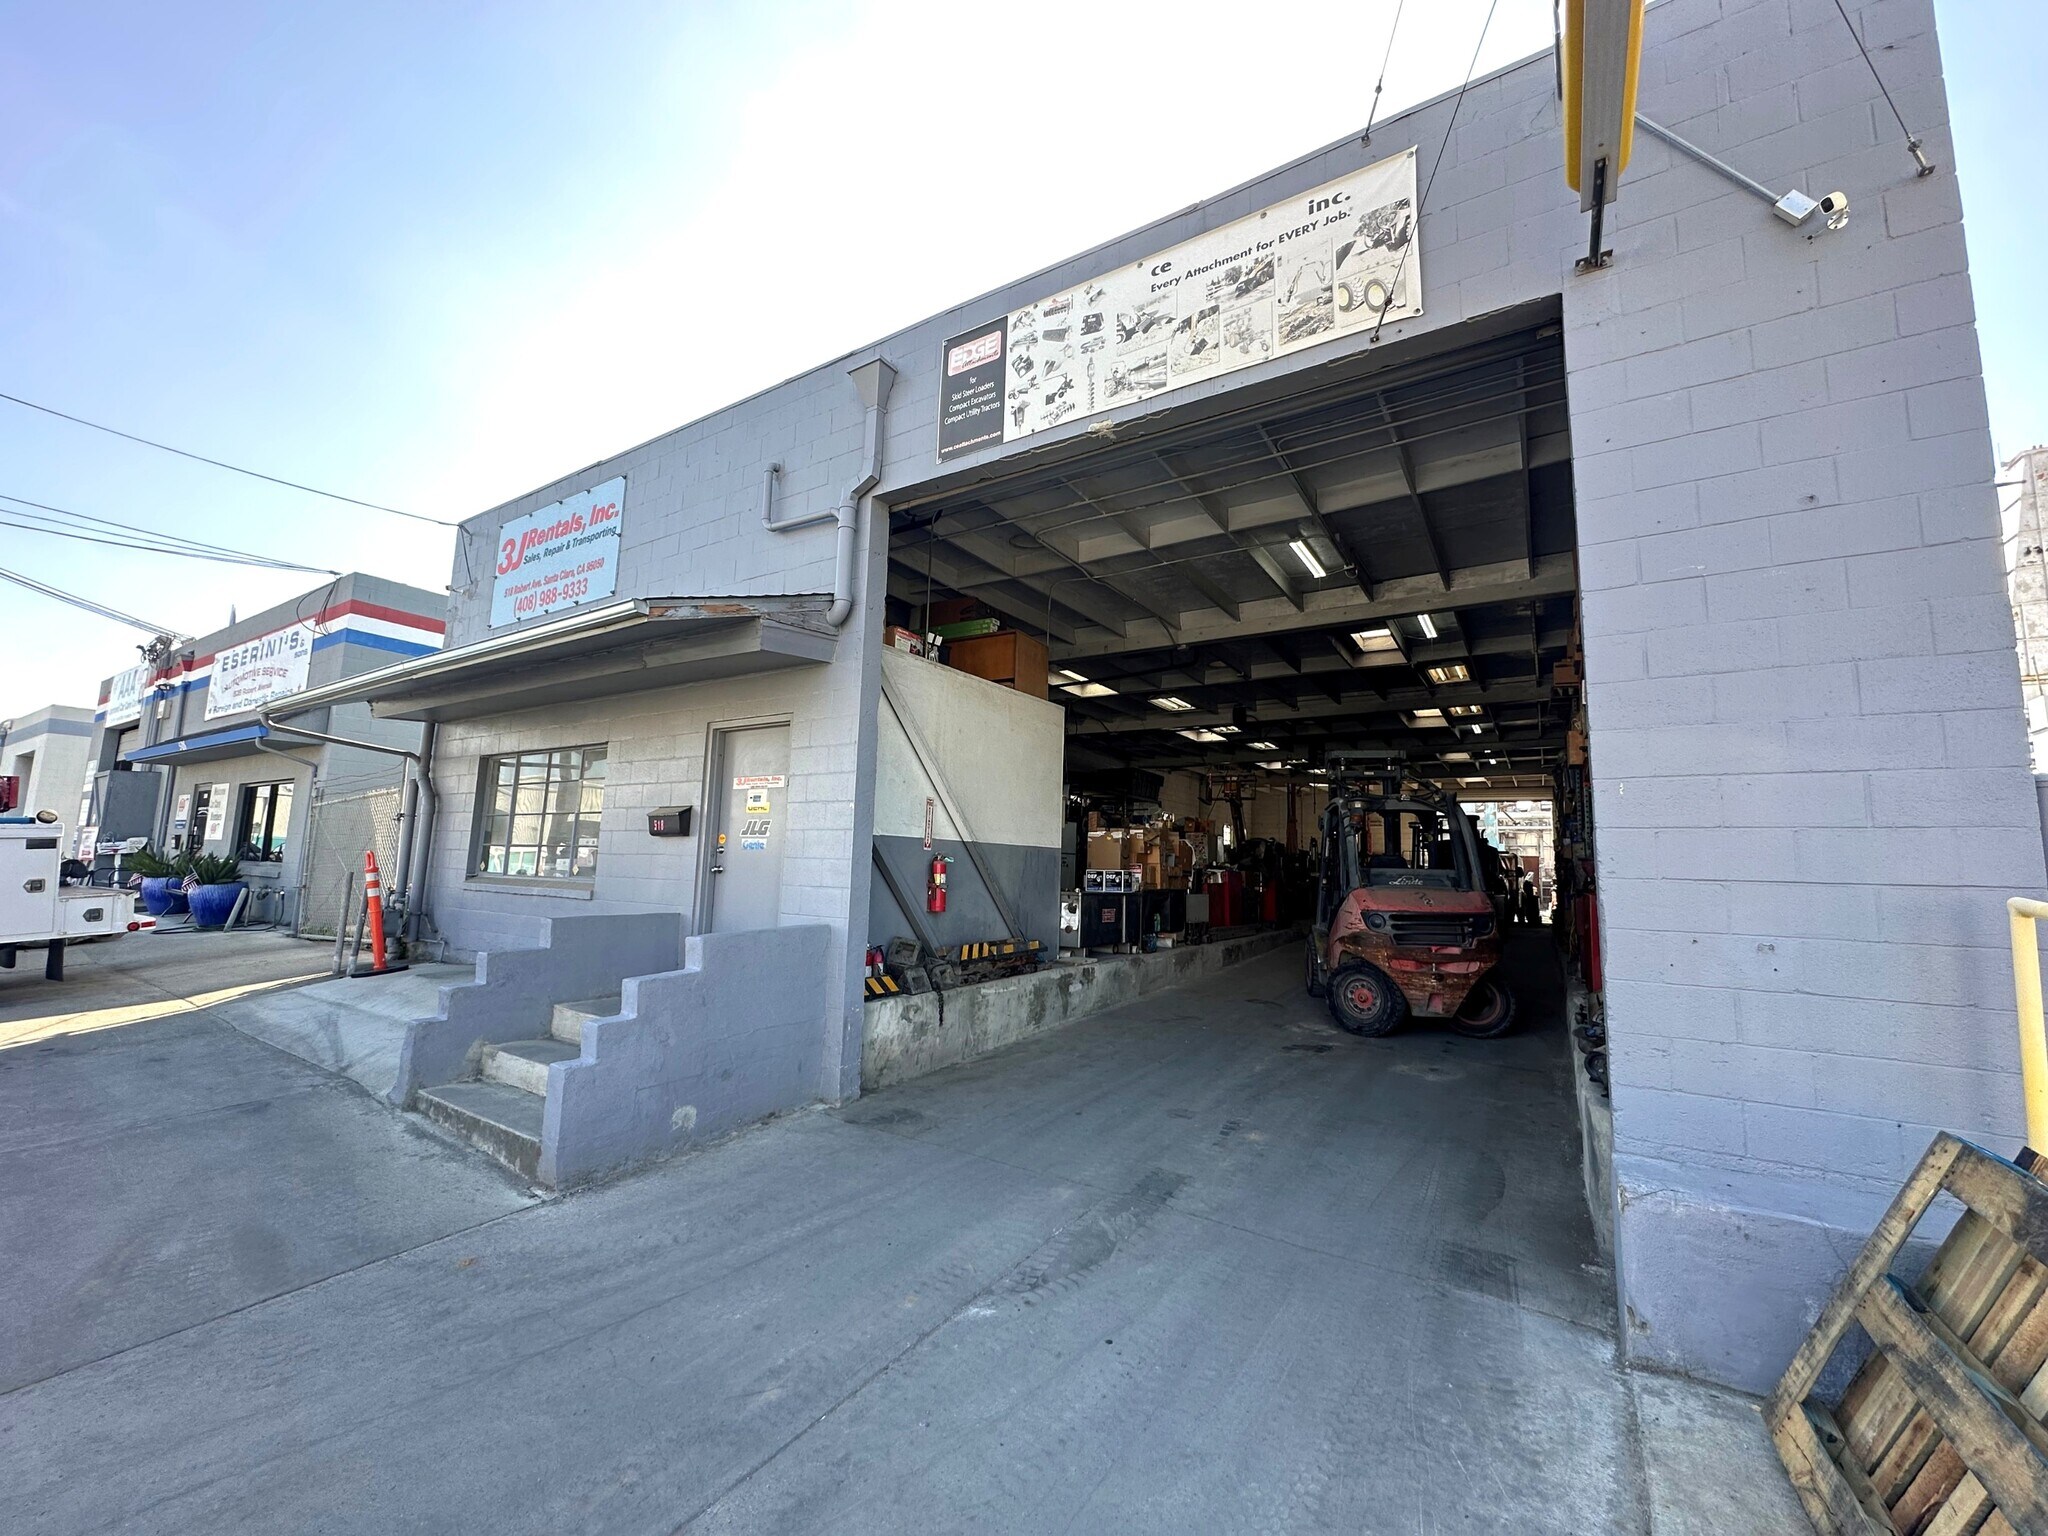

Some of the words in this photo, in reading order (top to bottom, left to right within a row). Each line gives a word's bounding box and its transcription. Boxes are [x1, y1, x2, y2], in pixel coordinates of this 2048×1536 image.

[1308, 192, 1351, 215] inc.
[1151, 276, 1182, 293] Every
[1184, 247, 1253, 280] Attachment
[1256, 239, 1275, 252] for
[1279, 220, 1319, 244] EVERY
[1323, 210, 1351, 226] Job.
[1151, 261, 1173, 277] ce
[952, 333, 998, 367] EDGE
[951, 390, 962, 401] Skid
[963, 388, 975, 398] Steer
[975, 381, 995, 393] Loaders
[969, 377, 977, 385] for
[944, 412, 965, 425] Compact
[966, 407, 980, 418] Utility
[981, 401, 1000, 412] Tractors
[949, 400, 970, 413] Compact
[971, 391, 996, 405] Excavators
[526, 512, 587, 549] Rentals,
[589, 502, 620, 526] Inc.
[523, 552, 541, 565] Sales,
[543, 542, 566, 557] Repair
[565, 541, 571, 550] &
[572, 526, 617, 548] Transporting
[514, 582, 531, 594] Robert
[543, 574, 558, 585] Santa
[576, 564, 585, 575] CA
[513, 591, 537, 618] (408)
[539, 577, 588, 607] 988-9333
[222, 631, 300, 672] ESERINI'S
[261, 667, 289, 678] SERVICE
[741, 820, 771, 836] JLG
[1388, 875, 1424, 885] Linde
